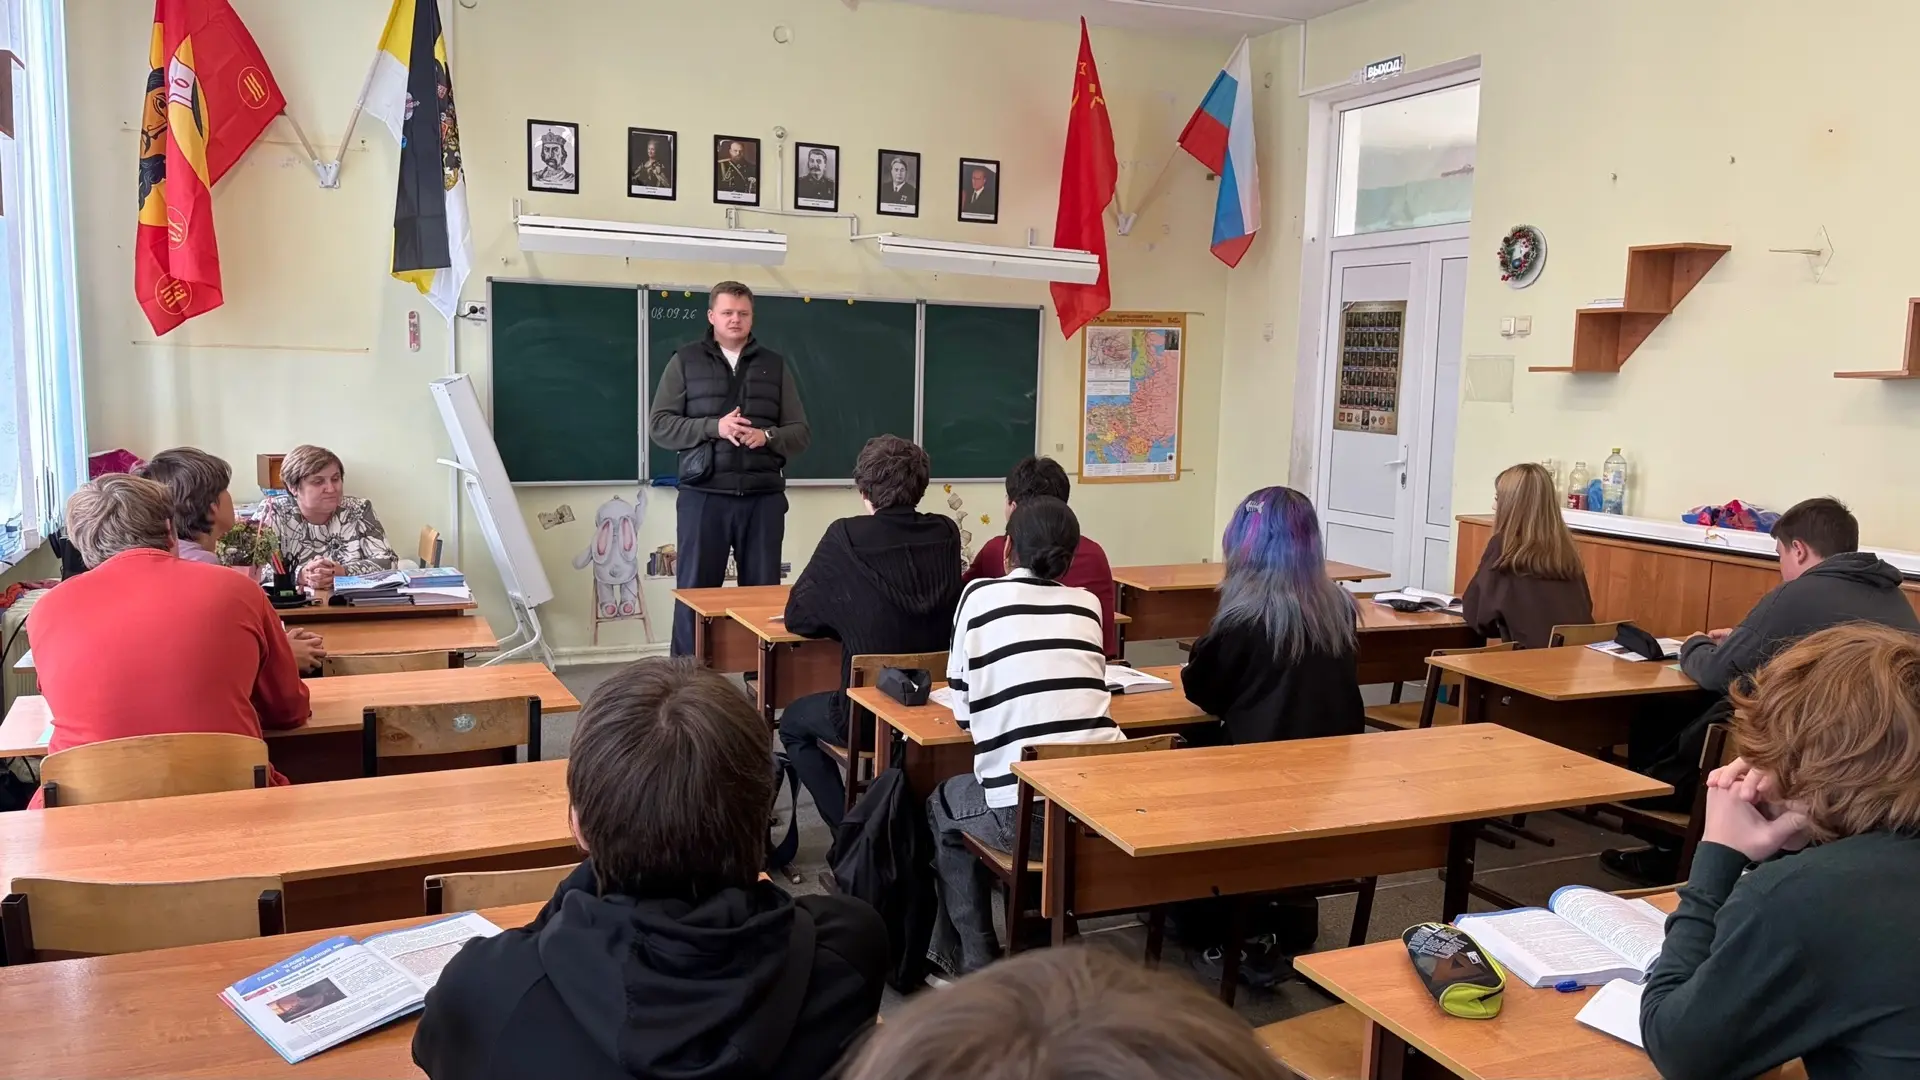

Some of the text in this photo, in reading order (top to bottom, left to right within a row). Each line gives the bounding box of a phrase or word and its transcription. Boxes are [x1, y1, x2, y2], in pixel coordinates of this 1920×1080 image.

[1368, 59, 1400, 78] ВЫХОД
[281, 955, 308, 969] ЧЕЛОВЕК
[292, 947, 332, 970] ОКРУЖАЮЩИЙ
